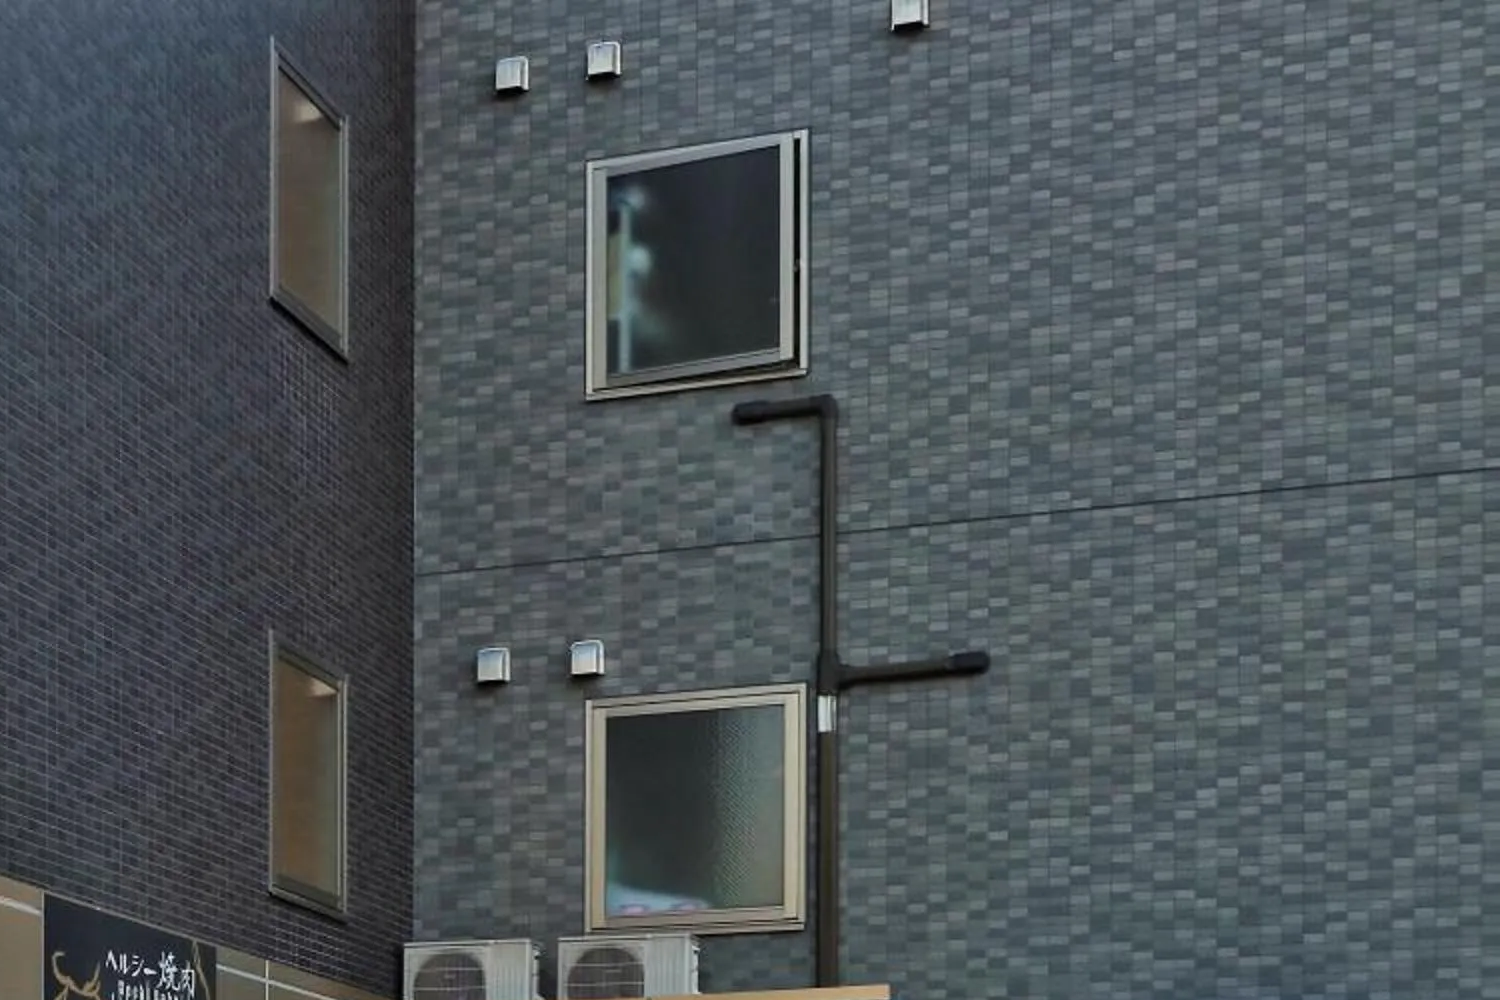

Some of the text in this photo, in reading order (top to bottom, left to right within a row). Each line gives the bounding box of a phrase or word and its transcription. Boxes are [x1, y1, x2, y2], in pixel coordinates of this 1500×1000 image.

[105, 951, 195, 999] ヘルシー焼肉
